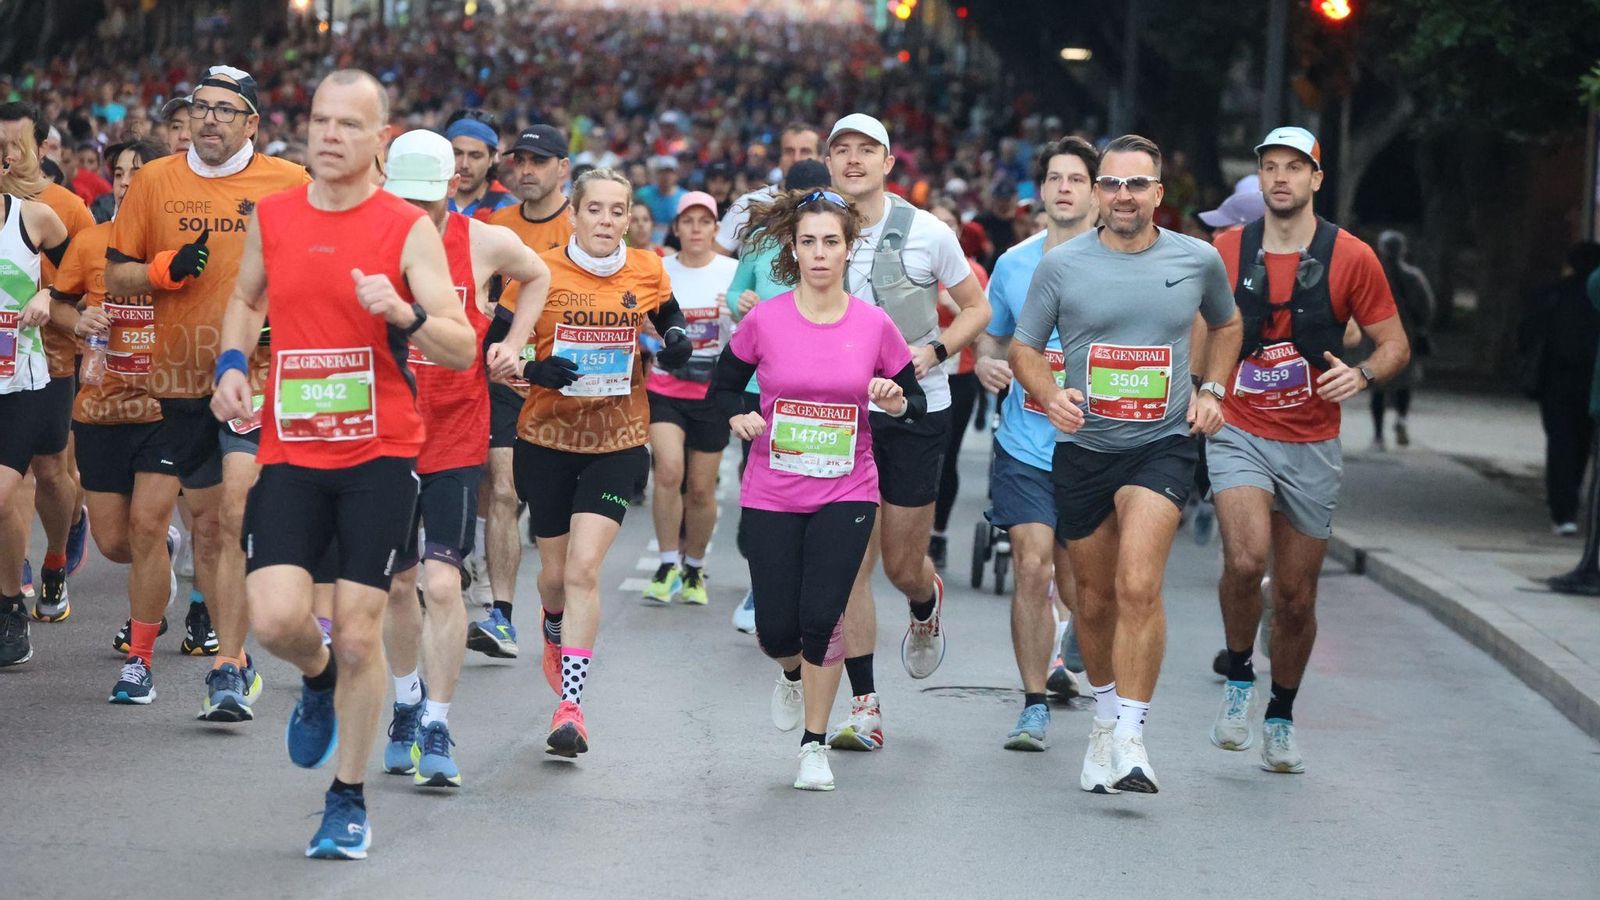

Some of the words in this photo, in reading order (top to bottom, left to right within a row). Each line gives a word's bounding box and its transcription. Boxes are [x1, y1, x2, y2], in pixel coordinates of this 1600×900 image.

[164, 200, 212, 214] CORRE
[548, 293, 597, 307] CORRE
[577, 331, 630, 342] GENERALI
[300, 353, 365, 369] GENERALI
[571, 351, 615, 365] 14551
[1112, 349, 1165, 362] GENERALI
[1109, 373, 1150, 388] 3504
[1253, 369, 1290, 382] 3559
[300, 383, 347, 400] 3042
[797, 405, 851, 420] GENERALI
[790, 426, 838, 445] 14709
